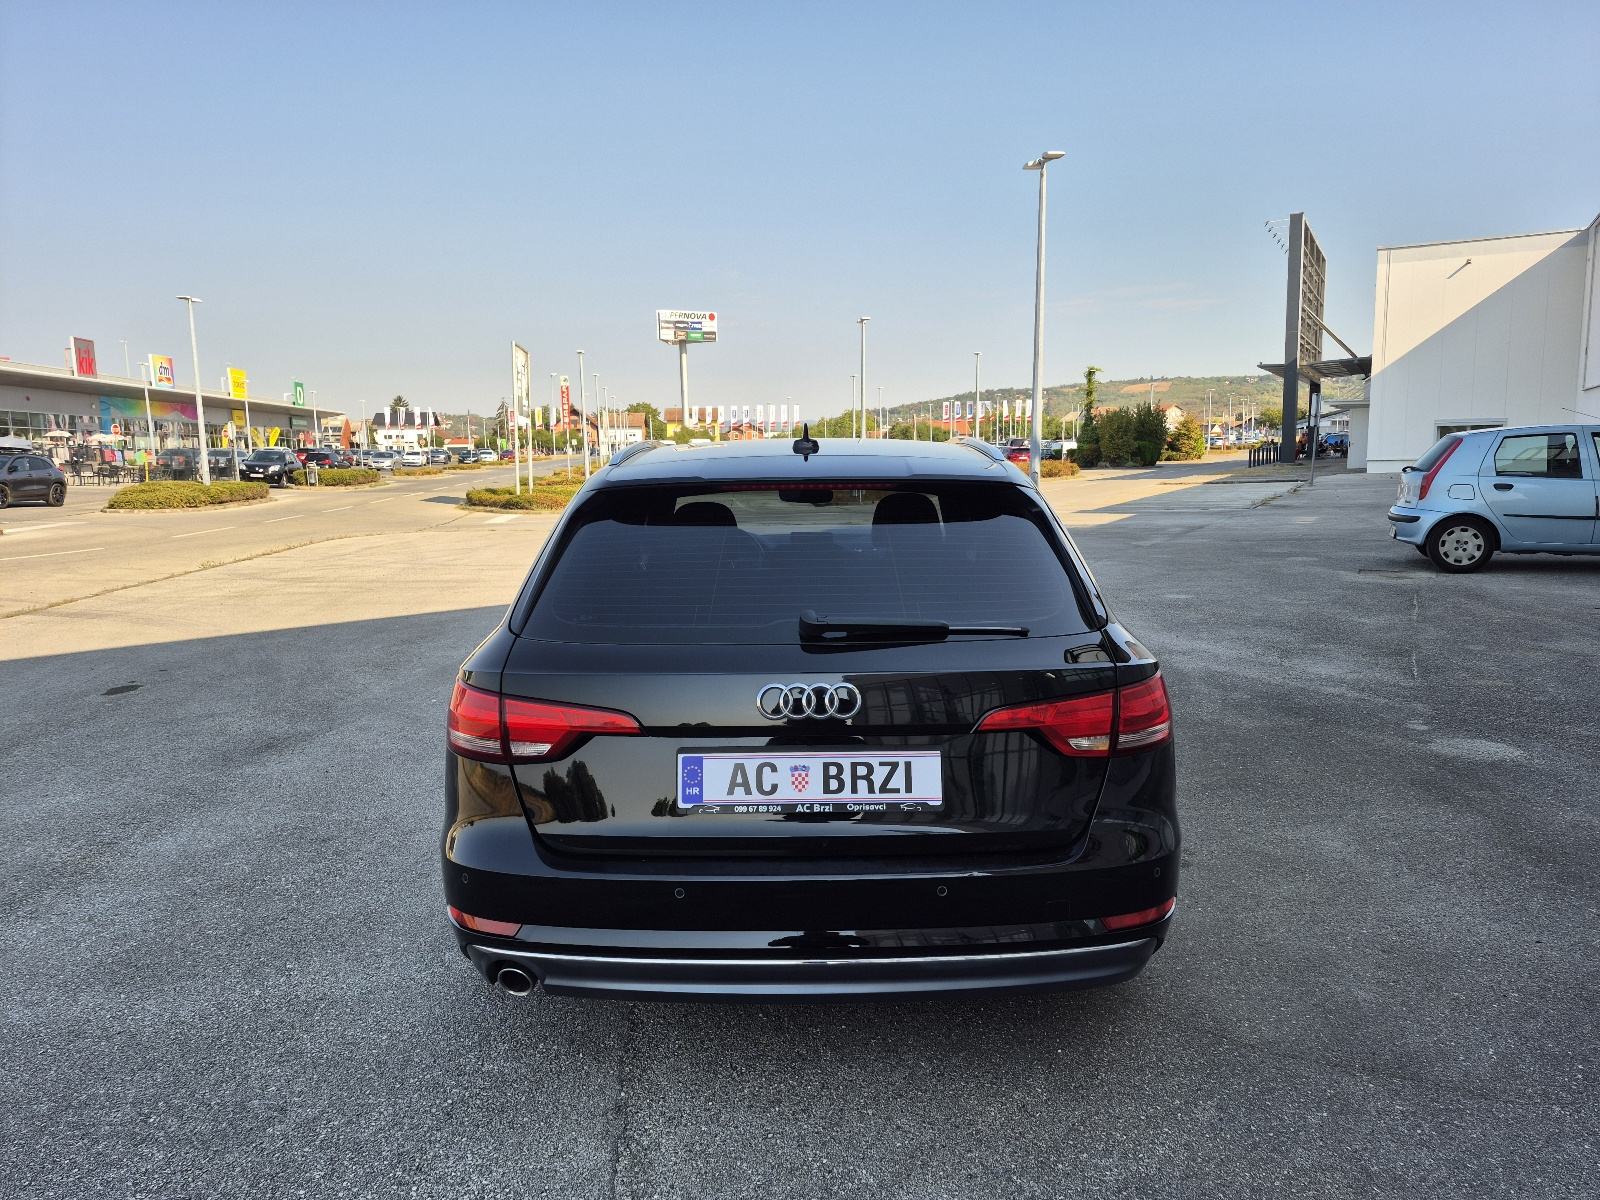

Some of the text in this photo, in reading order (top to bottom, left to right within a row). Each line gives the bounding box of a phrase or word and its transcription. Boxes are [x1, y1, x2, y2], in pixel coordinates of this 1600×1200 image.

[661, 312, 707, 320] PERNOVA
[726, 761, 913, 796] AC BRZI
[685, 786, 700, 796] HR
[734, 804, 782, 813] 099 67 89 924
[795, 803, 833, 813] AC Brzi
[846, 803, 887, 812] Oprisavci
